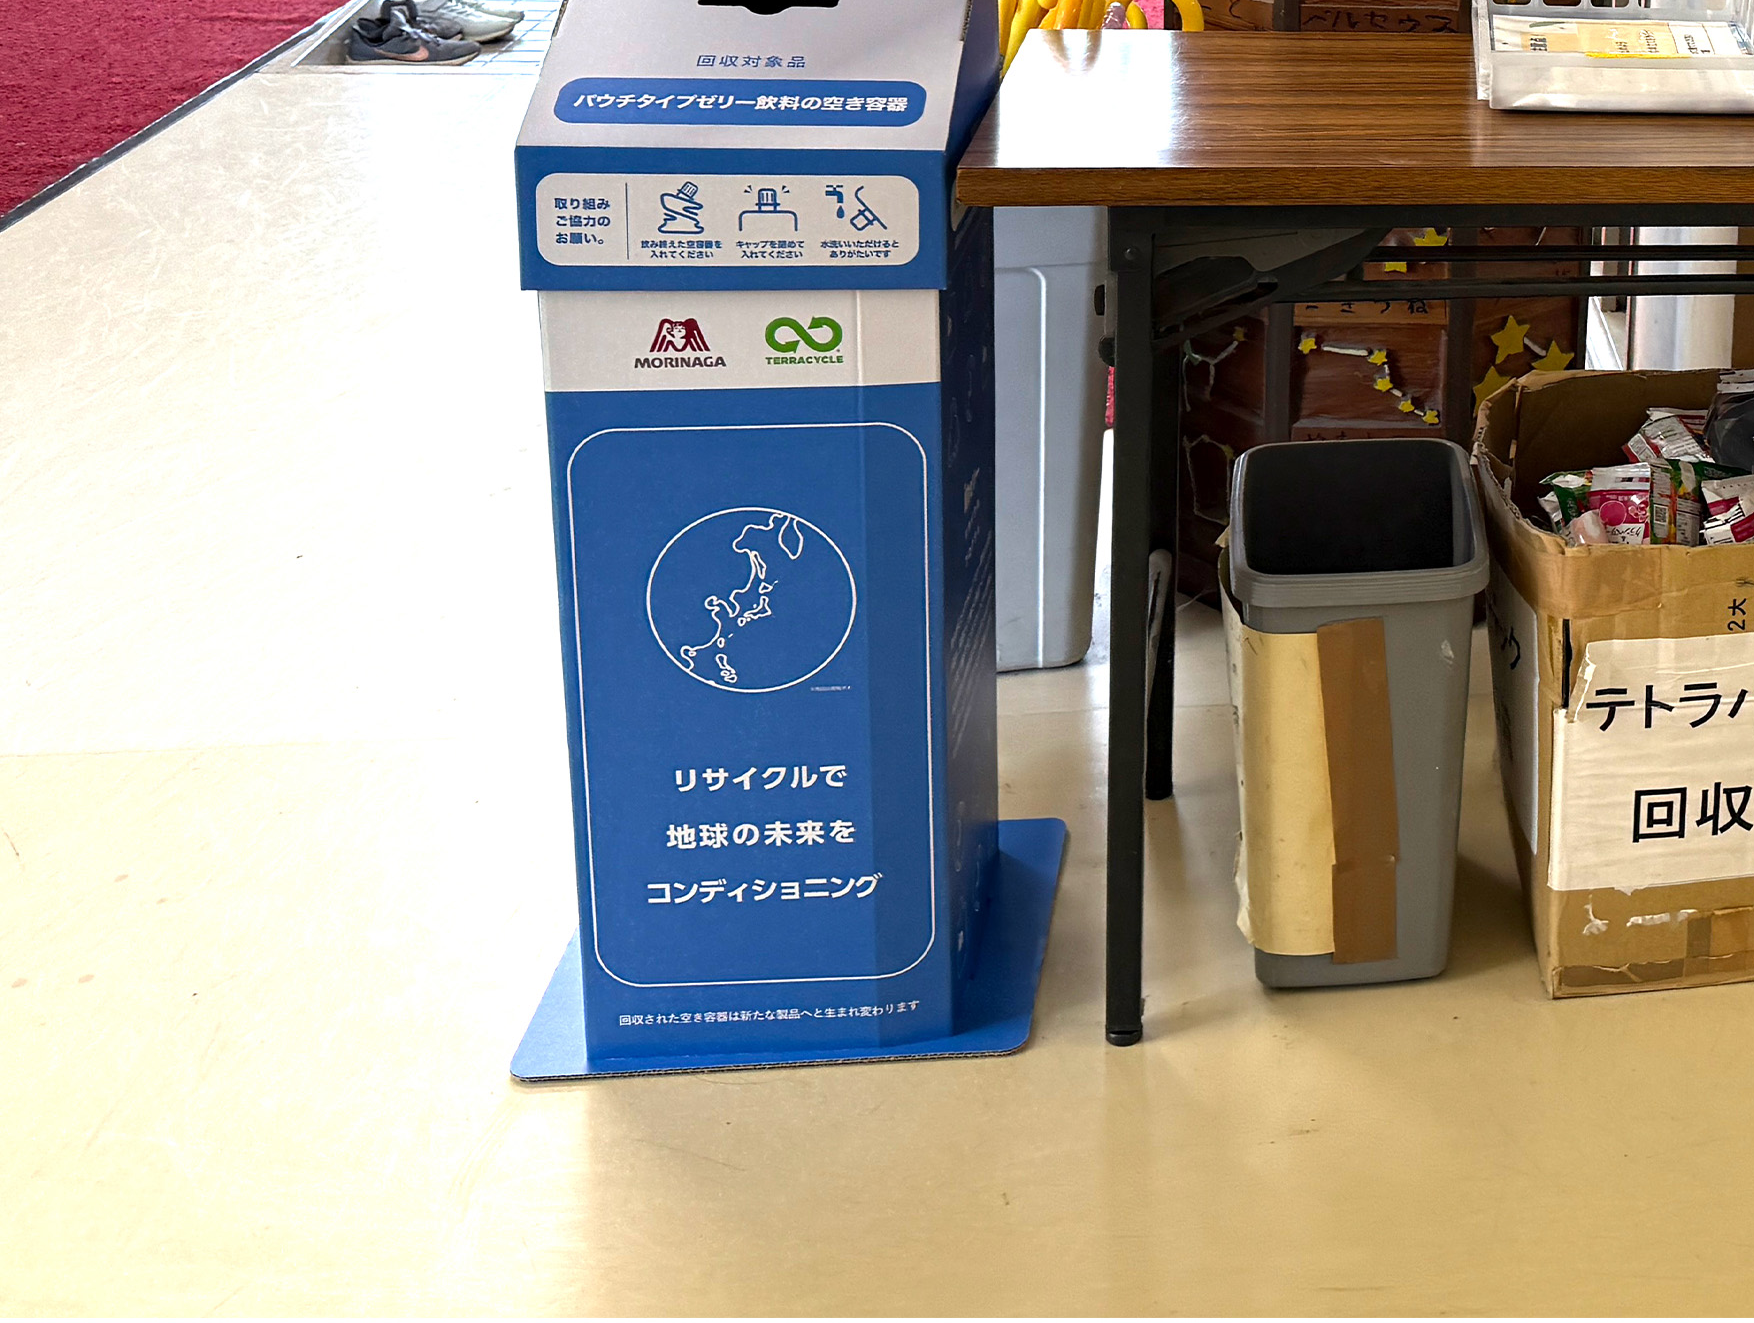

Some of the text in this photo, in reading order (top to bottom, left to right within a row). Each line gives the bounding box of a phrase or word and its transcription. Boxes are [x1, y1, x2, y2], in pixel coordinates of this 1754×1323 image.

[696, 54, 808, 69] 回収対象品
[573, 92, 909, 113] パウチタイプゼリー飲料の空き容器
[553, 196, 611, 212] 取り組み
[555, 214, 611, 229] ご協力の
[555, 231, 606, 246] お願い。
[650, 249, 892, 260] 入れてください 入れてください ありがたいです
[633, 354, 844, 370] MORINAGA TERRACYCLE
[673, 764, 848, 792] リサイクルで
[666, 819, 857, 850] 地球の未来を
[646, 871, 884, 907] コンディショニング
[618, 1000, 921, 1027] 回収された空き容器は新たな製品へと生まれ変わります
